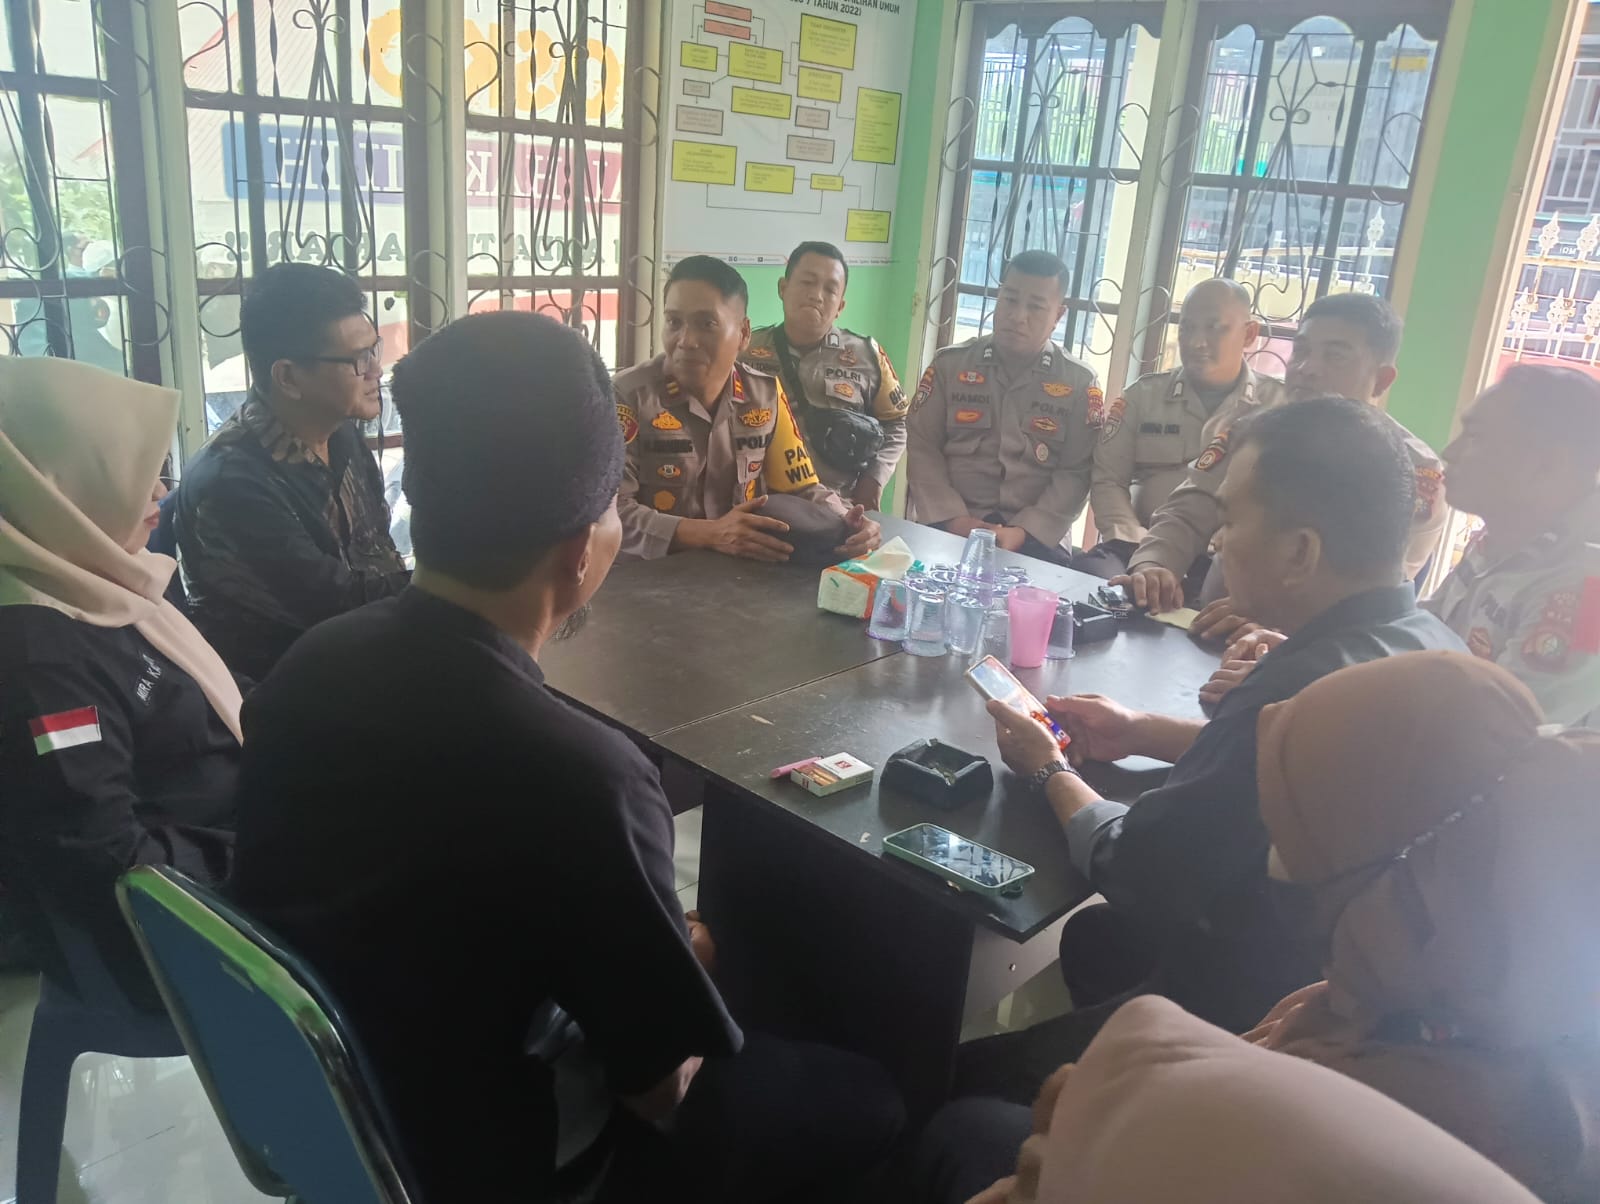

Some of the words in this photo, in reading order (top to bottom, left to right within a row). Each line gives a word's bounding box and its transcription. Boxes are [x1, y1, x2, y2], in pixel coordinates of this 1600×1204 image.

[813, 0, 838, 12] TAHUN
[880, 1, 900, 15] UMUM
[825, 367, 861, 382] POLRI
[1030, 401, 1070, 417] POLRI
